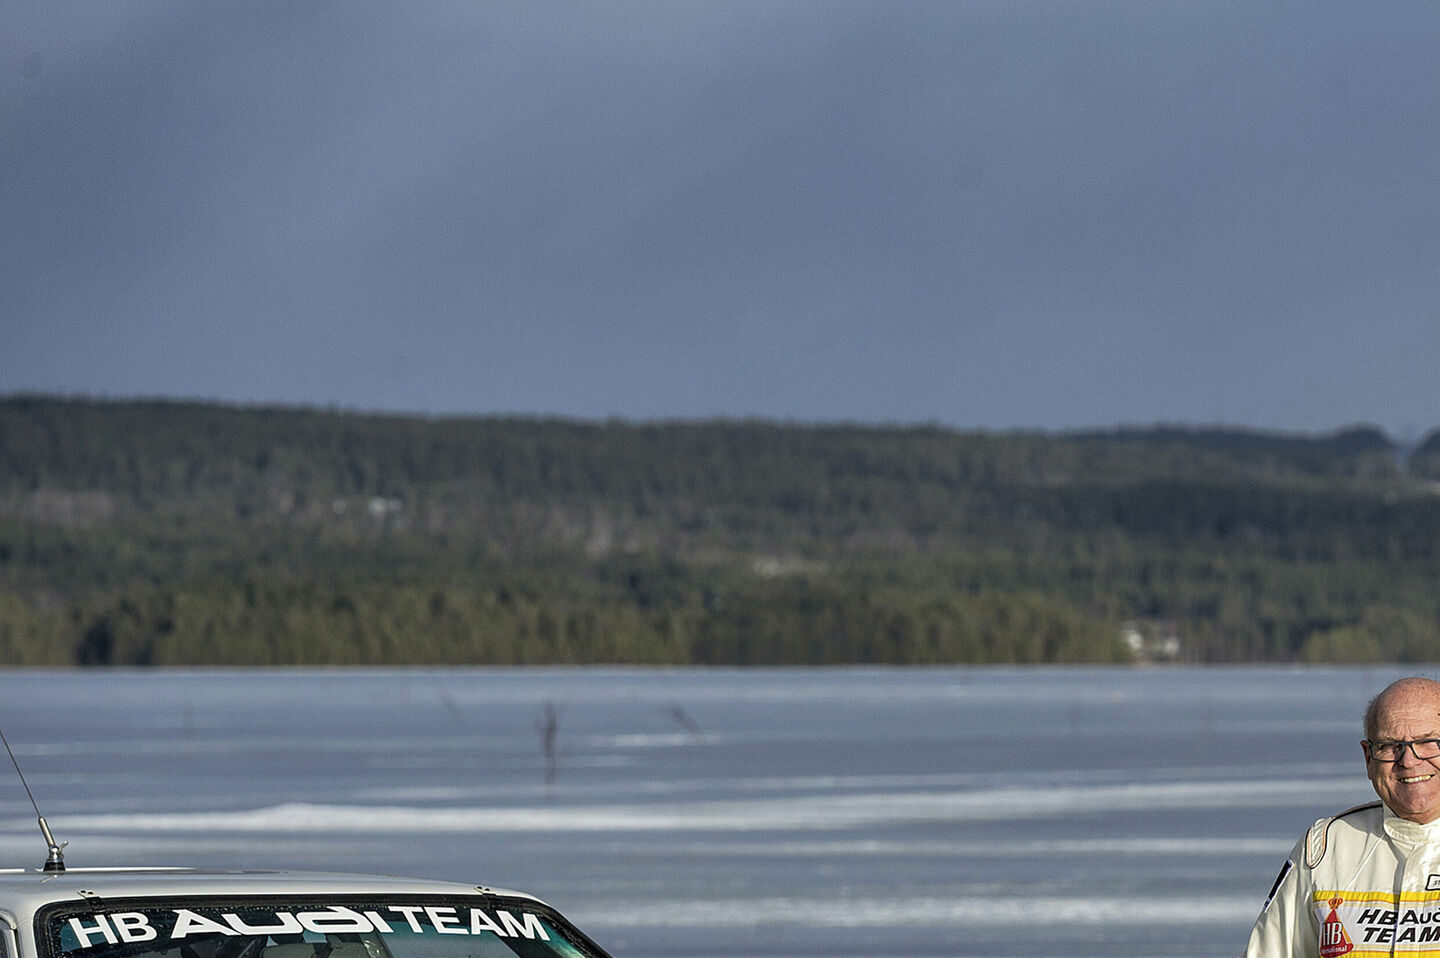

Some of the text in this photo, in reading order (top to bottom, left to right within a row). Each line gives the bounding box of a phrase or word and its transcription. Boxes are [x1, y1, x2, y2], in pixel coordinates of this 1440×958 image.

[68, 911, 157, 948] HB
[388, 906, 550, 941] TEAM
[1356, 909, 1398, 925] HB
[1321, 922, 1342, 946] HB
